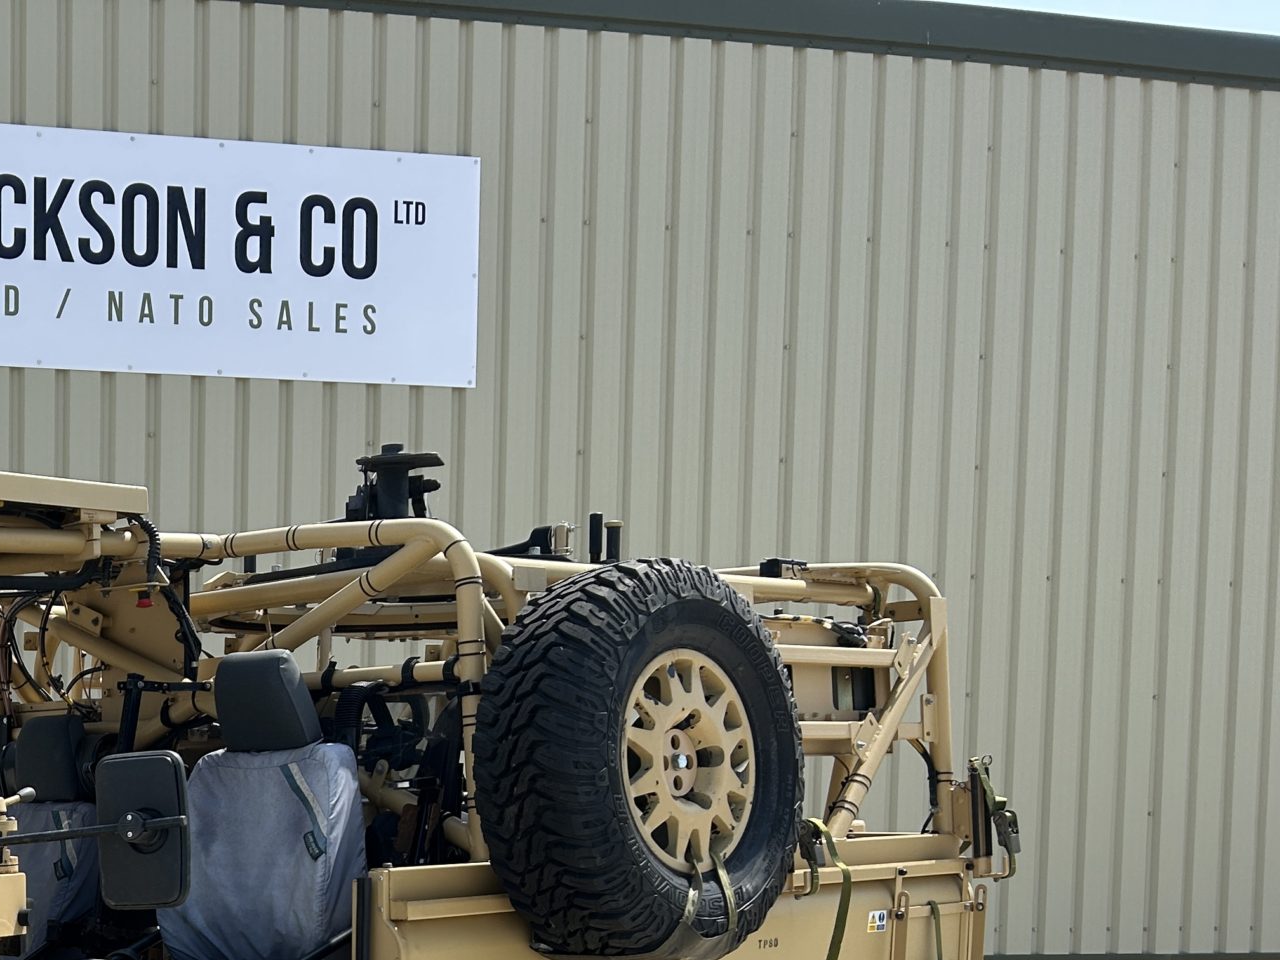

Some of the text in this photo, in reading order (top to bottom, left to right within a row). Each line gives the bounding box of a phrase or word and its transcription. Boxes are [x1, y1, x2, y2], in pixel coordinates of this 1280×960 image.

[234, 190, 275, 274] &
[299, 194, 378, 280] CO
[393, 199, 426, 225] LTD
[55, 288, 72, 319] /
[106, 290, 214, 328] NATO
[248, 297, 378, 336] SALES
